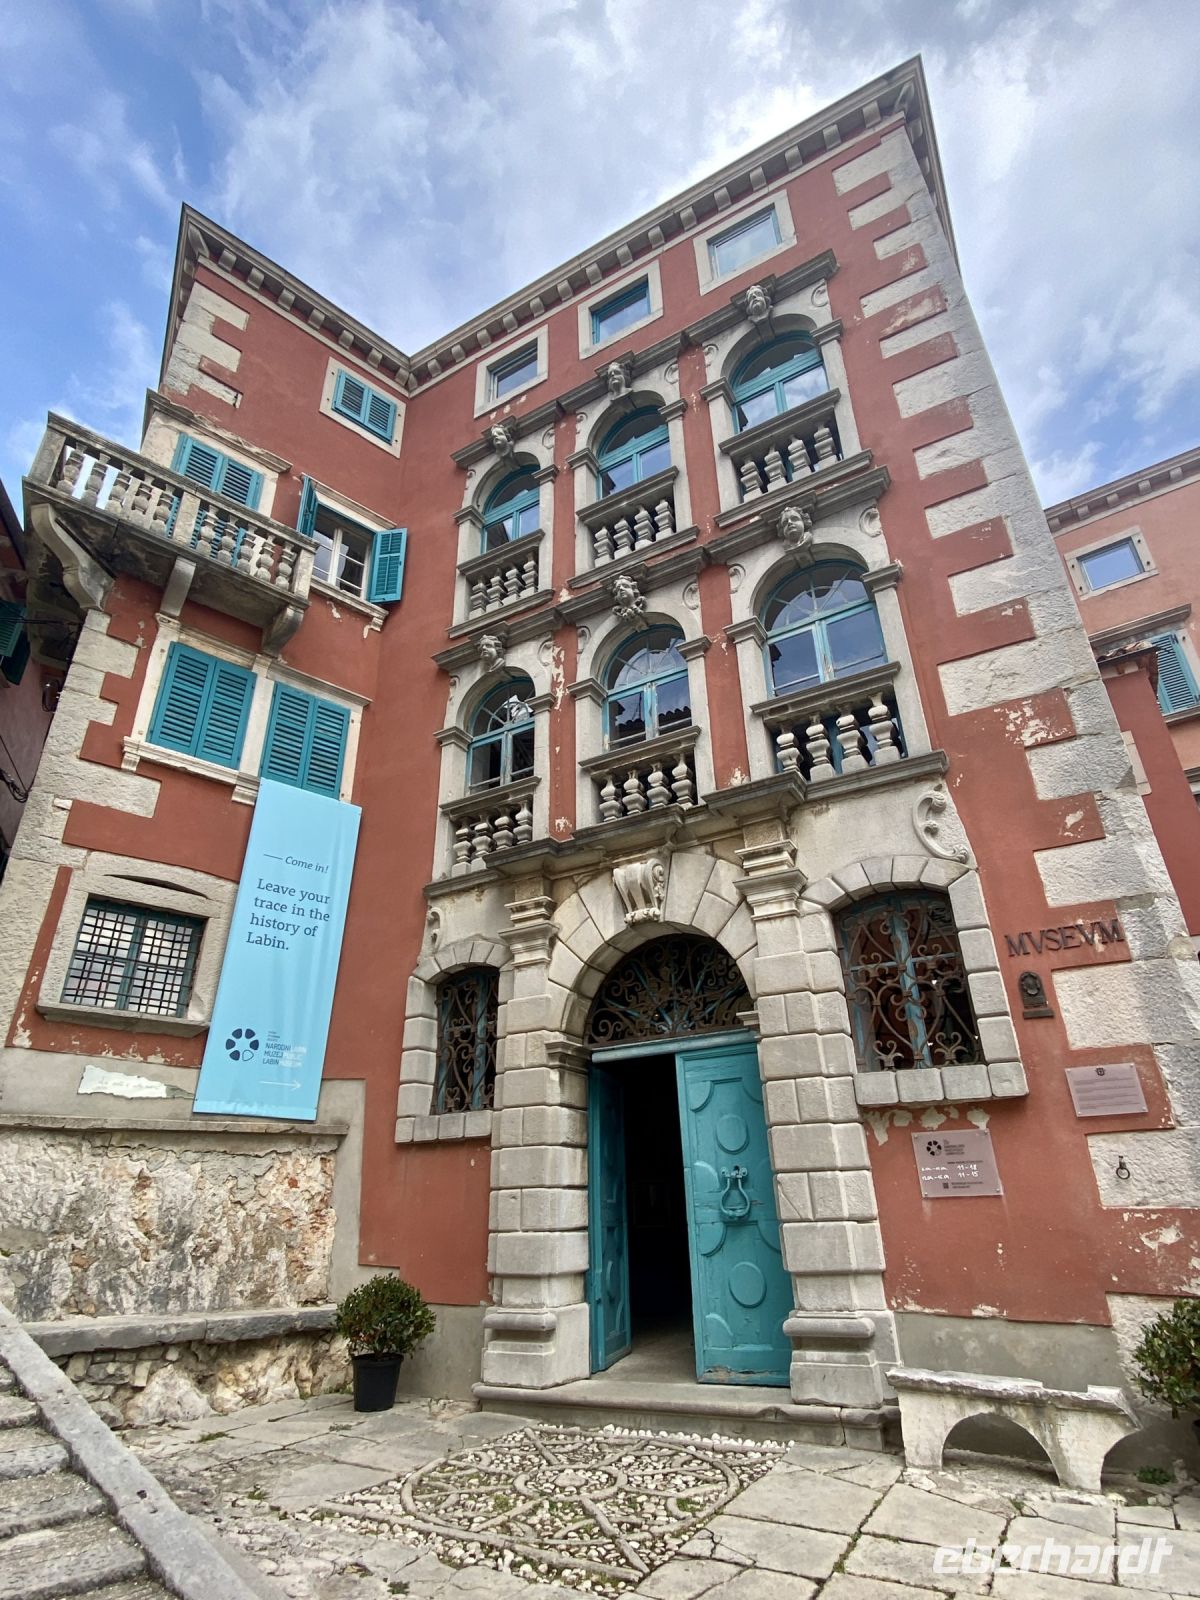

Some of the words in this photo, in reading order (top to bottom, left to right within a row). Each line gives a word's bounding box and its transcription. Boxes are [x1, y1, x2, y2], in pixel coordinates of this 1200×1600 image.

[285, 855, 313, 869] Come
[315, 862, 329, 873] in!
[256, 878, 296, 896] Leave
[299, 889, 331, 904] your
[254, 897, 288, 912] trace
[291, 903, 305, 916] in
[309, 908, 330, 921] the
[249, 912, 301, 935] history
[303, 925, 319, 937] of
[245, 931, 289, 950] Labin.
[263, 1050, 284, 1058] MUZEJ
[265, 1042, 292, 1051] NARODNI
